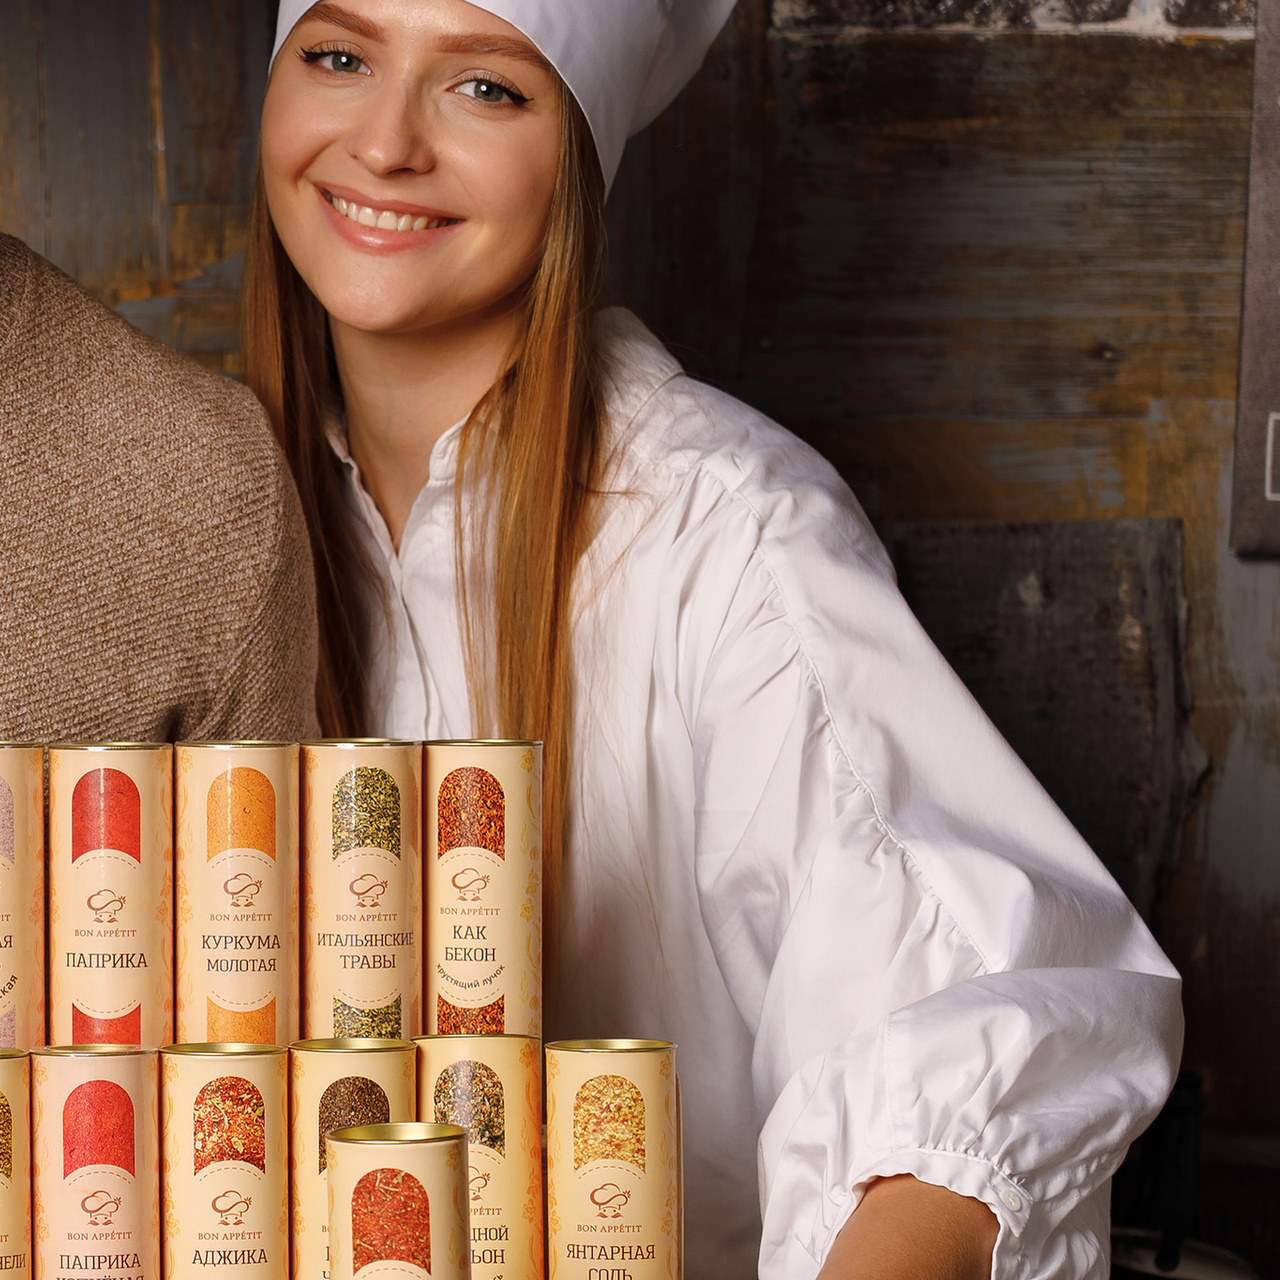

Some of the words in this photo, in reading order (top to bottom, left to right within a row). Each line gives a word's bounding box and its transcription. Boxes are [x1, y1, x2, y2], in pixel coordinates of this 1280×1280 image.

[209, 913, 231, 922] BON
[335, 913, 357, 922] BON
[439, 906, 458, 916] BON
[74, 929, 94, 938] BON
[317, 932, 414, 948] ИТАЛЬЯНСКИЕ
[453, 925, 487, 940] КАК
[201, 934, 281, 950] КУРКУМА
[66, 952, 148, 969] ПАПРИКА
[444, 946, 496, 962] БЕКОН
[206, 958, 277, 973] МОЛОТАЯ
[339, 954, 396, 970] ТРАВЫ
[436, 964, 480, 989] хрустящий
[482, 964, 506, 986] лучок
[577, 1224, 598, 1233] BON
[67, 1232, 89, 1241] BON
[197, 1232, 219, 1241] BON
[191, 1248, 268, 1268] АДЖИКА
[566, 1243, 656, 1261] ЯНТАРНАЯ
[59, 1253, 141, 1270] ПАПРИКА
